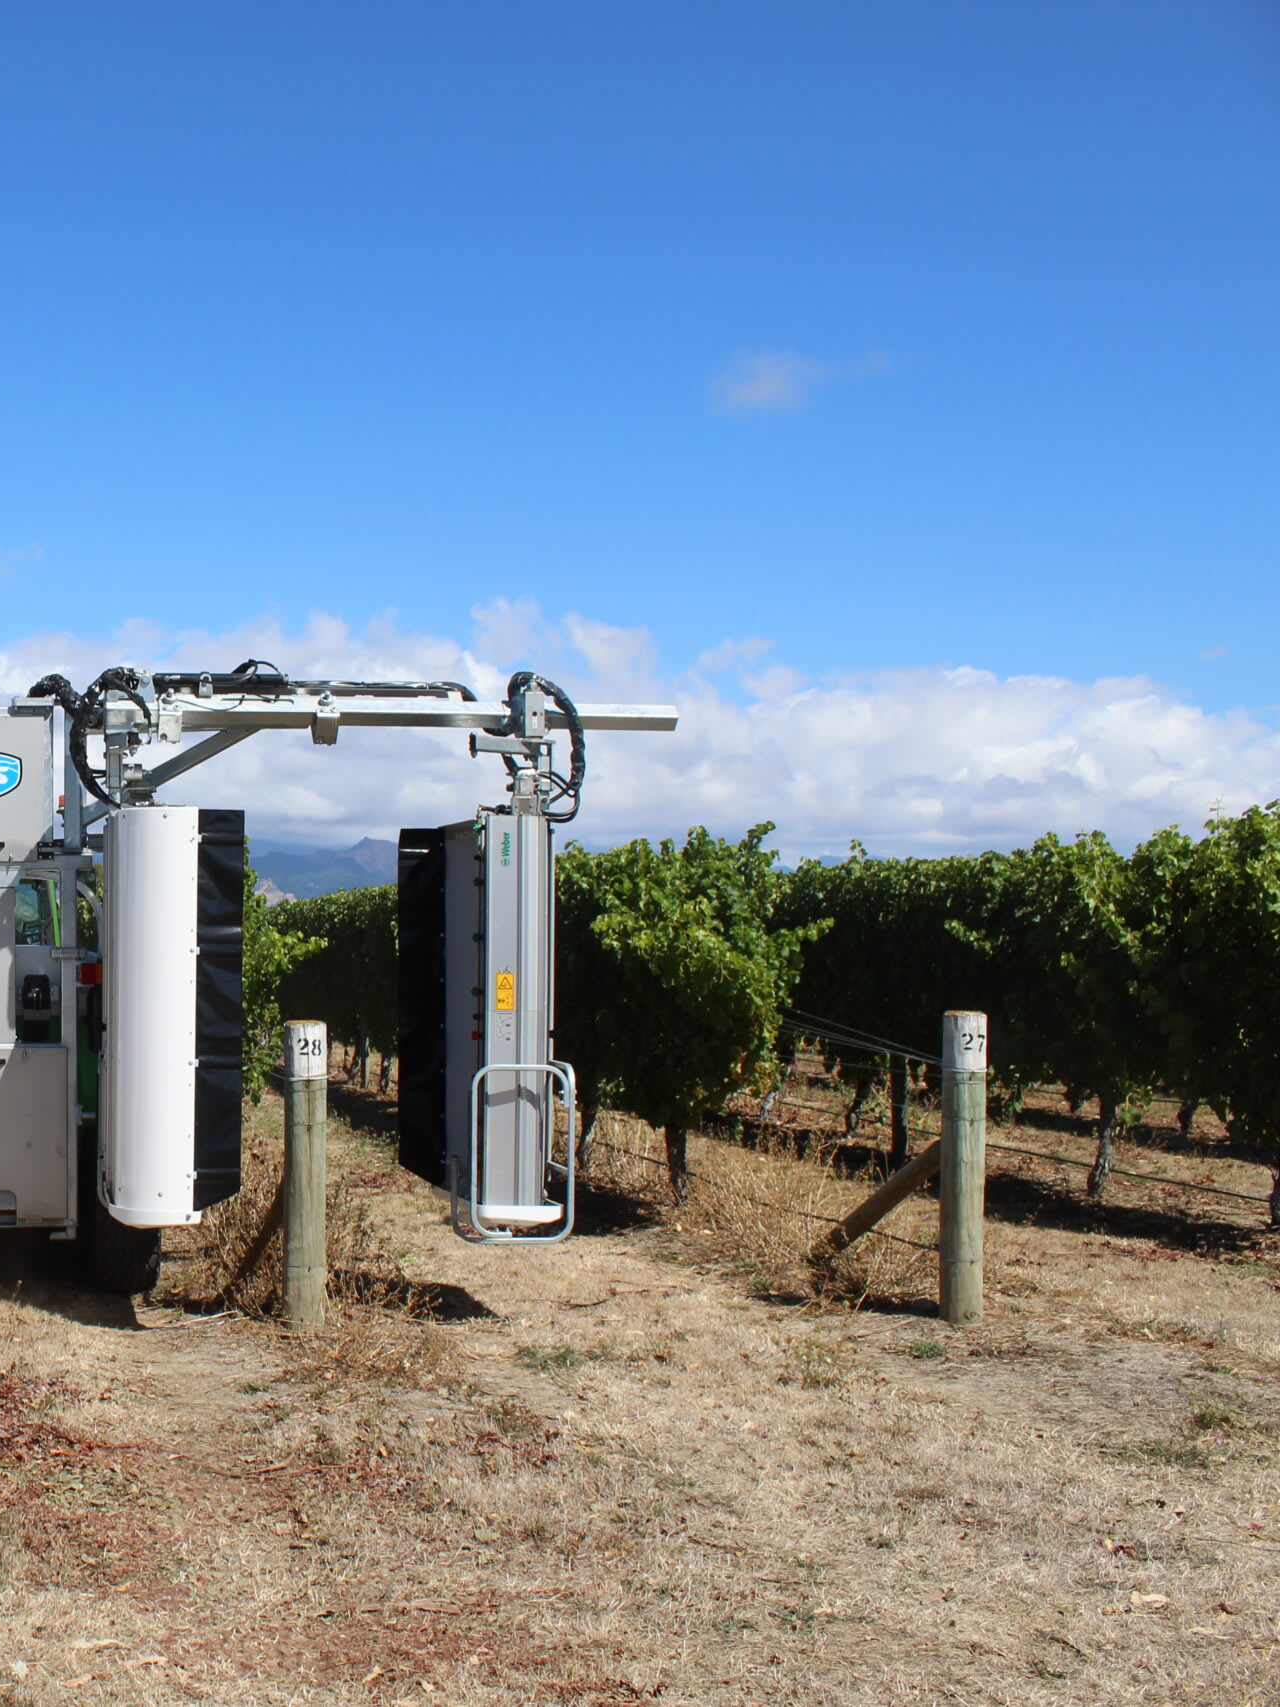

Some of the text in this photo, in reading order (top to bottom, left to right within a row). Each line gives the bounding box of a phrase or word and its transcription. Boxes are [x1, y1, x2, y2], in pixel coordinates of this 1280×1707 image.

[501, 832, 510, 857] Weber
[297, 1038, 322, 1057] 28
[961, 1033, 985, 1053] 27
